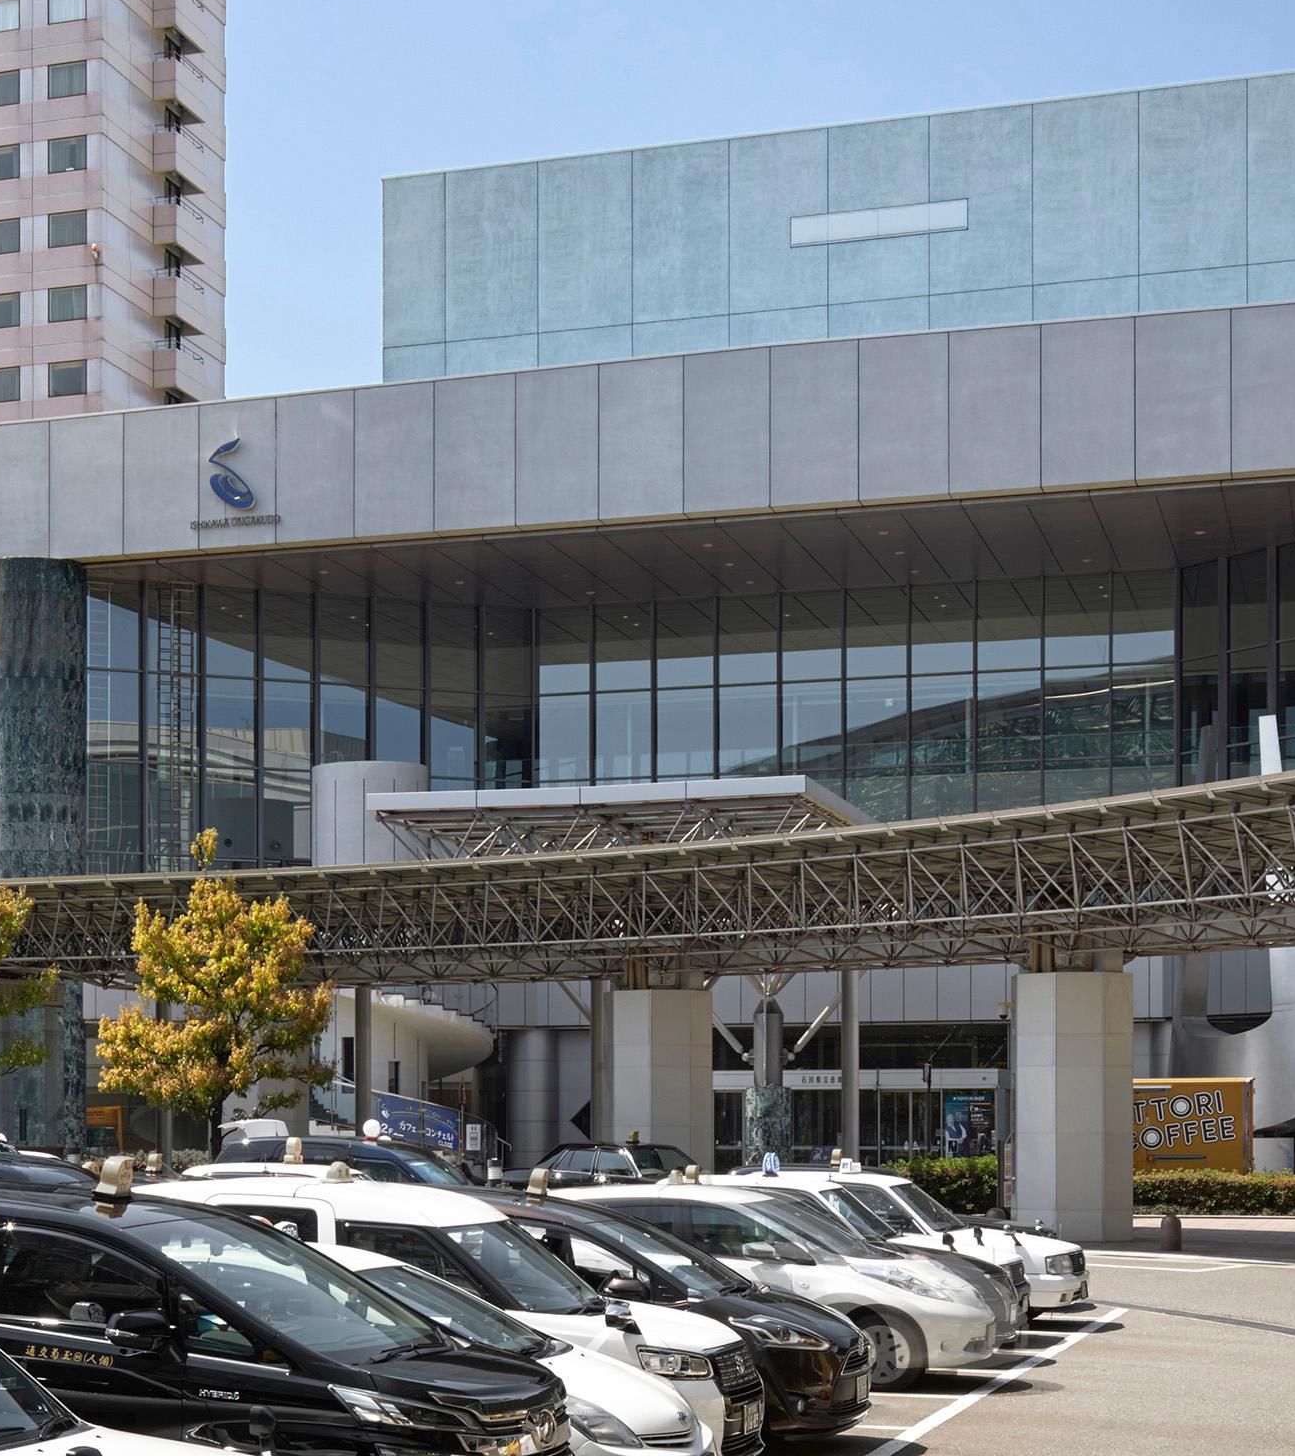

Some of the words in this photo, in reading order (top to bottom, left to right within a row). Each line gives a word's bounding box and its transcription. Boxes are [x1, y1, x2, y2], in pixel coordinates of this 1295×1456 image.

[190, 518, 230, 530] ISHIKAWA
[231, 514, 281, 526] ONGAKUDO
[400, 1120, 417, 1133] カフェ
